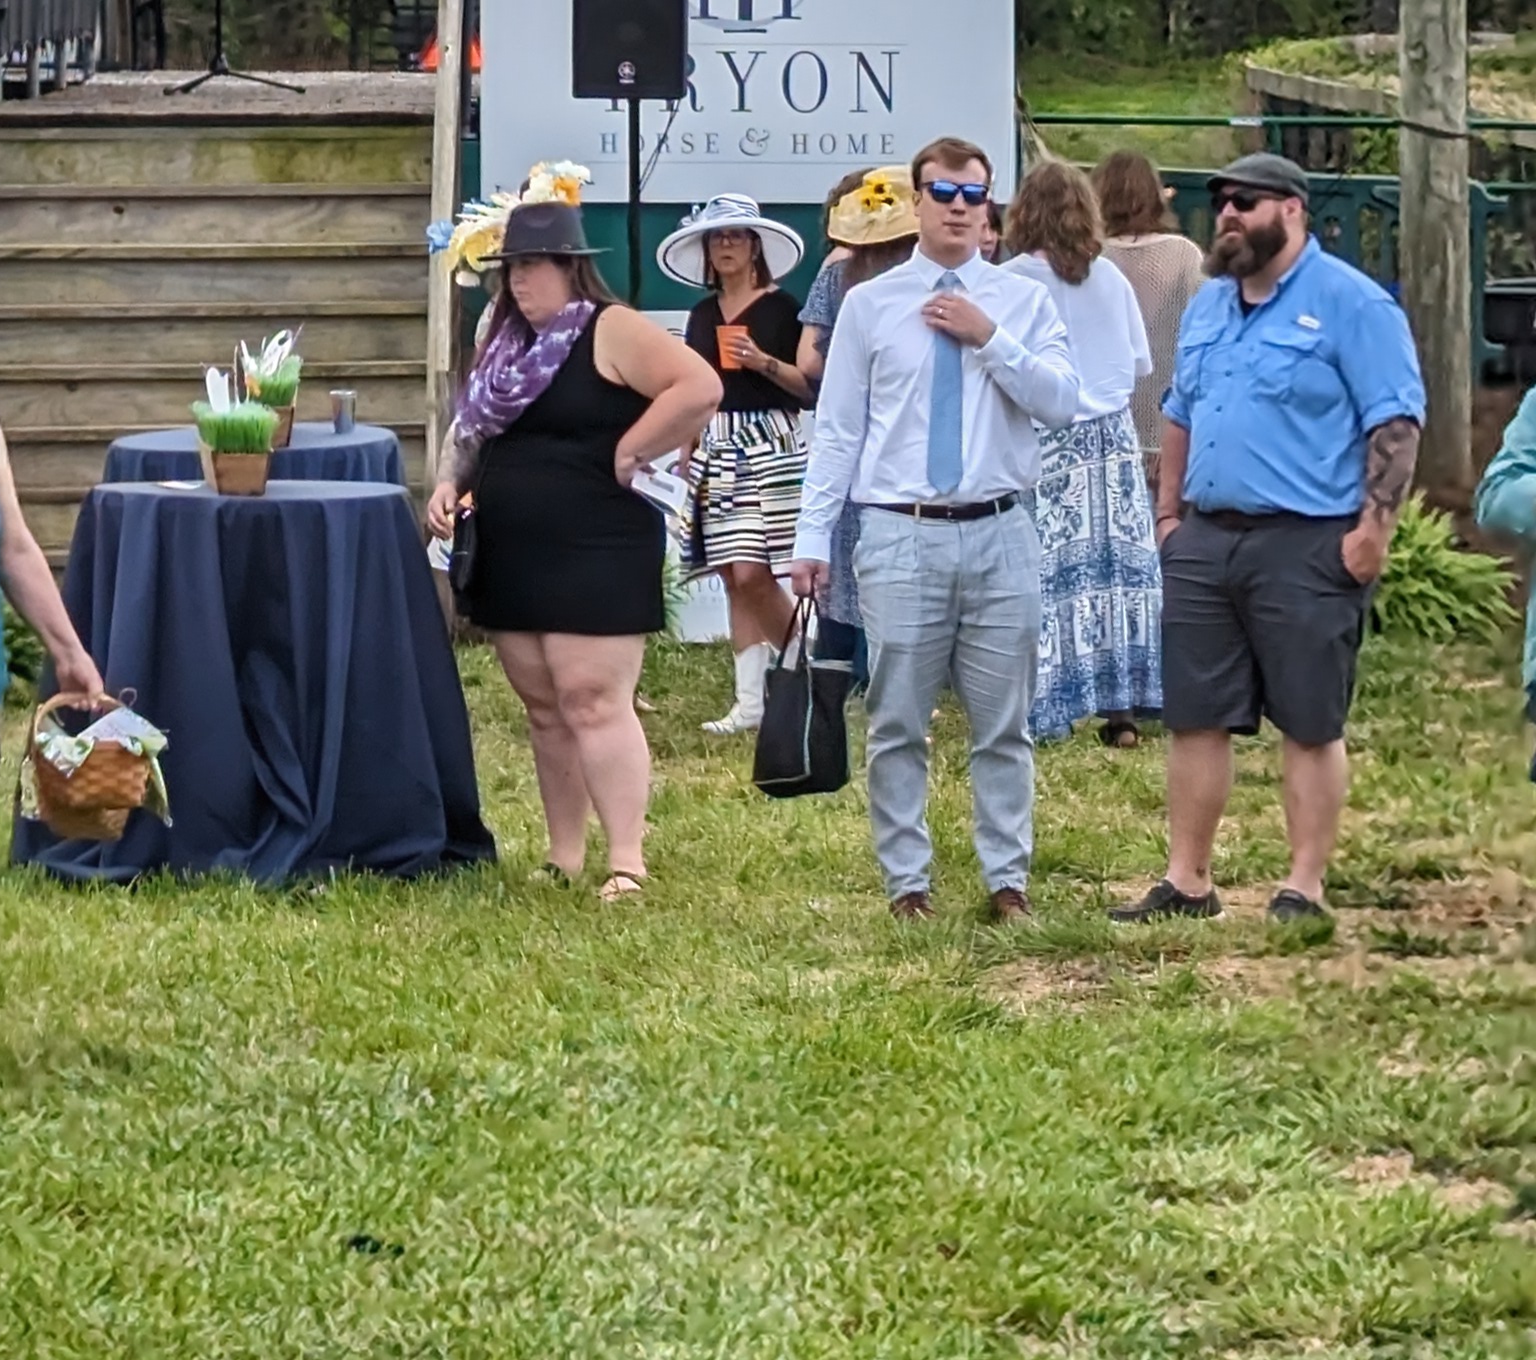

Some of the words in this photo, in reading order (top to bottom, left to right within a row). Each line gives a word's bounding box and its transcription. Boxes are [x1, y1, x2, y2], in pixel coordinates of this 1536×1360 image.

[600, 132, 720, 155] HRSE
[738, 128, 771, 157] &
[791, 133, 895, 155] HOME
